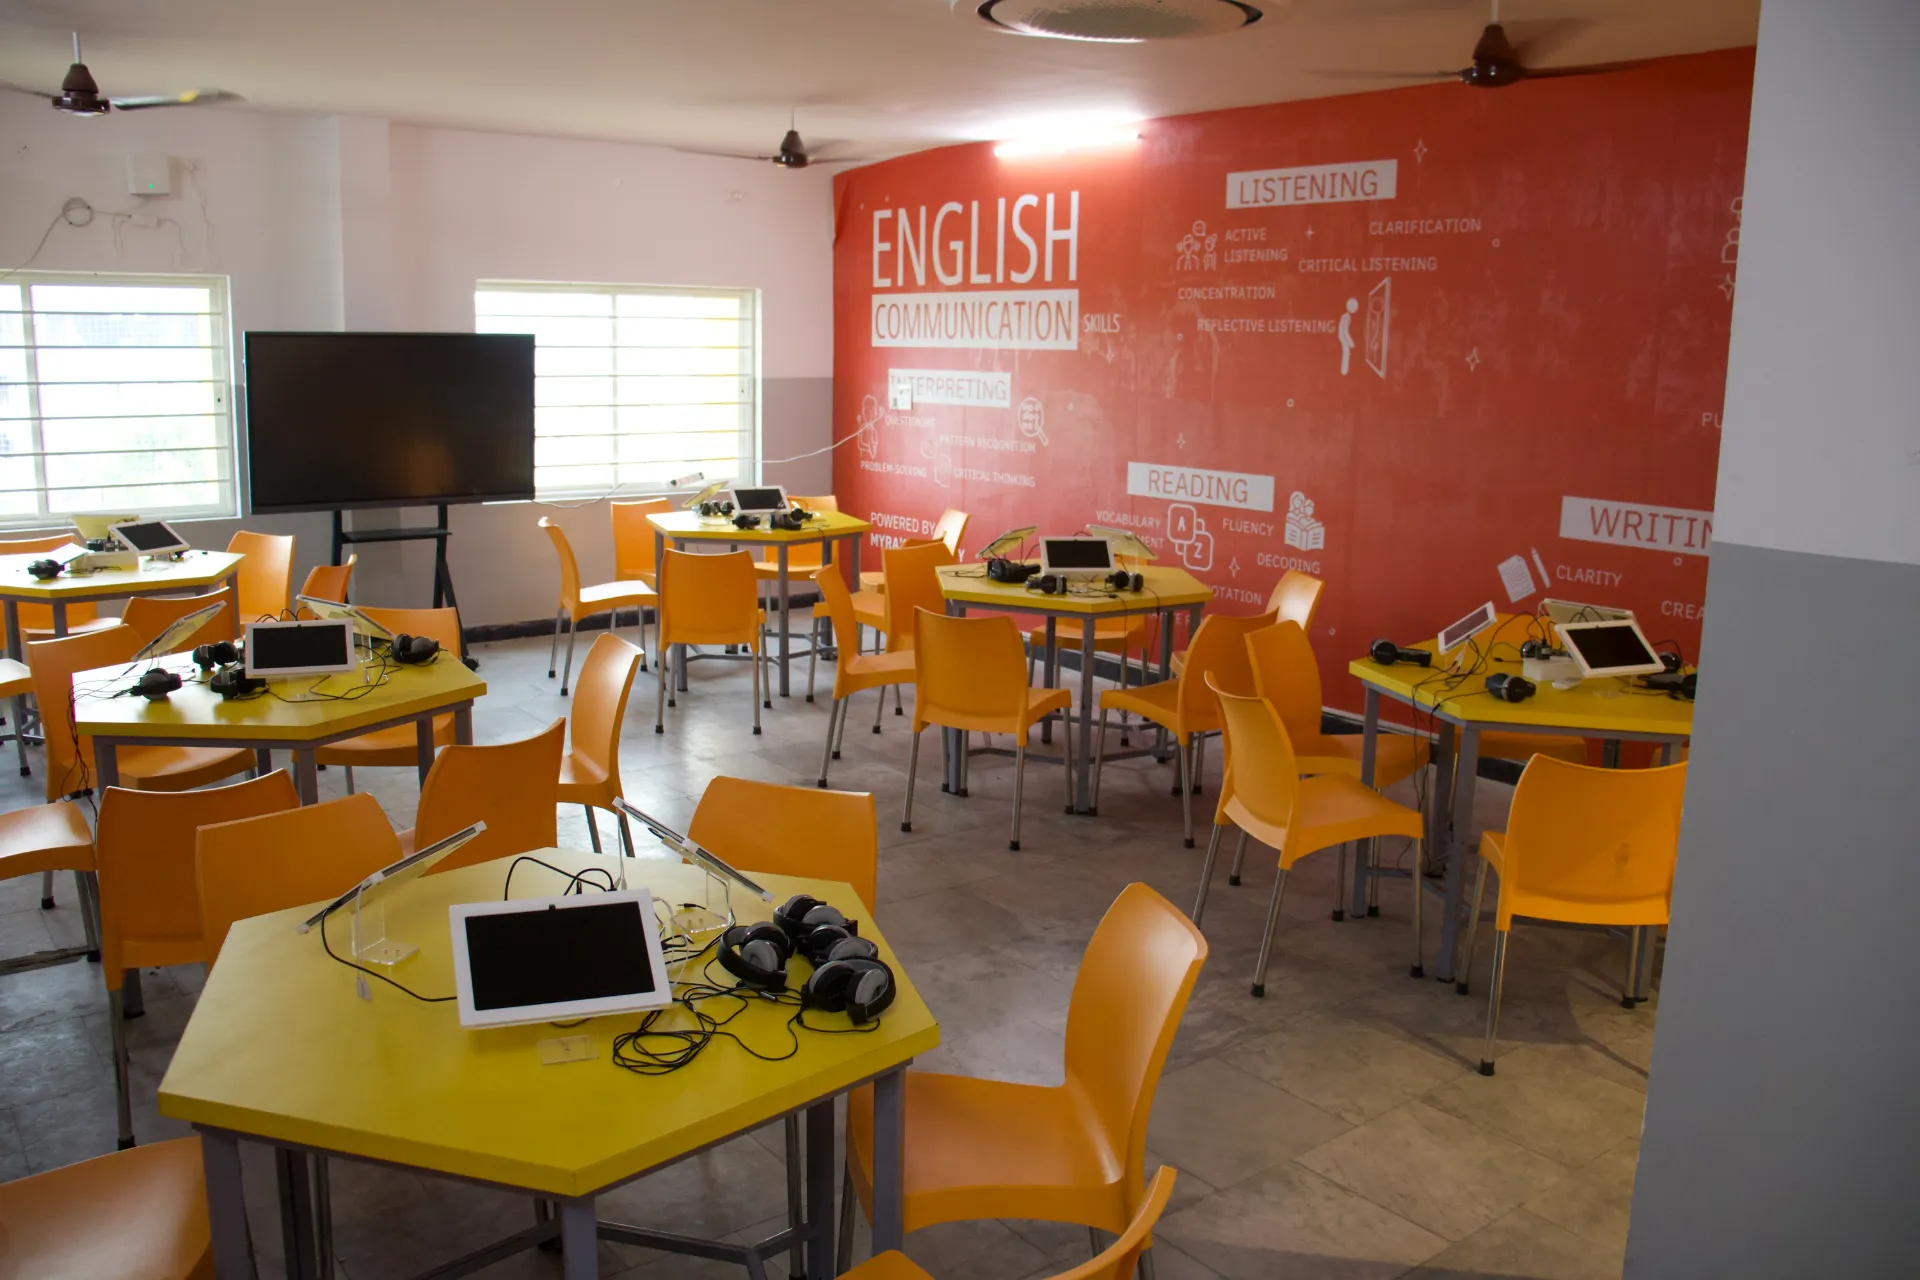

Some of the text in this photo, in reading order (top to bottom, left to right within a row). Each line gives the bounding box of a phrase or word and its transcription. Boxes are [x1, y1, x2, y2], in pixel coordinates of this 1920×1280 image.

[1239, 169, 1378, 204] LISTENING
[1224, 227, 1267, 242] ACTIVE
[1368, 217, 1481, 235] CLARIFICATION
[872, 190, 1079, 288] ENGLISH
[1223, 248, 1288, 263] LISTENING
[1298, 256, 1437, 272] CRITICAL LISTENING
[1177, 286, 1275, 300] CONCENTRATION
[875, 300, 1120, 341] COMMUNICATION SKILLS
[1197, 318, 1335, 334] REFLECTIVE LISTENING
[885, 415, 936, 429] QUESTIONING
[938, 434, 1036, 454] PATTERN RECOGNITION
[860, 460, 928, 478] PROBLEM-SOLVING
[953, 468, 1035, 488] CRITICAL THINKING
[1148, 469, 1248, 504] READING
[870, 512, 936, 536] POWERED BY
[1096, 510, 1161, 529] VOCABULARY
[1177, 517, 1186, 531] A
[1222, 517, 1274, 536] FLUENCY
[1193, 542, 1203, 558] Z
[1257, 552, 1320, 574] DECODING
[1555, 565, 1622, 587] CLARITY
[1208, 583, 1262, 606] OTATION
